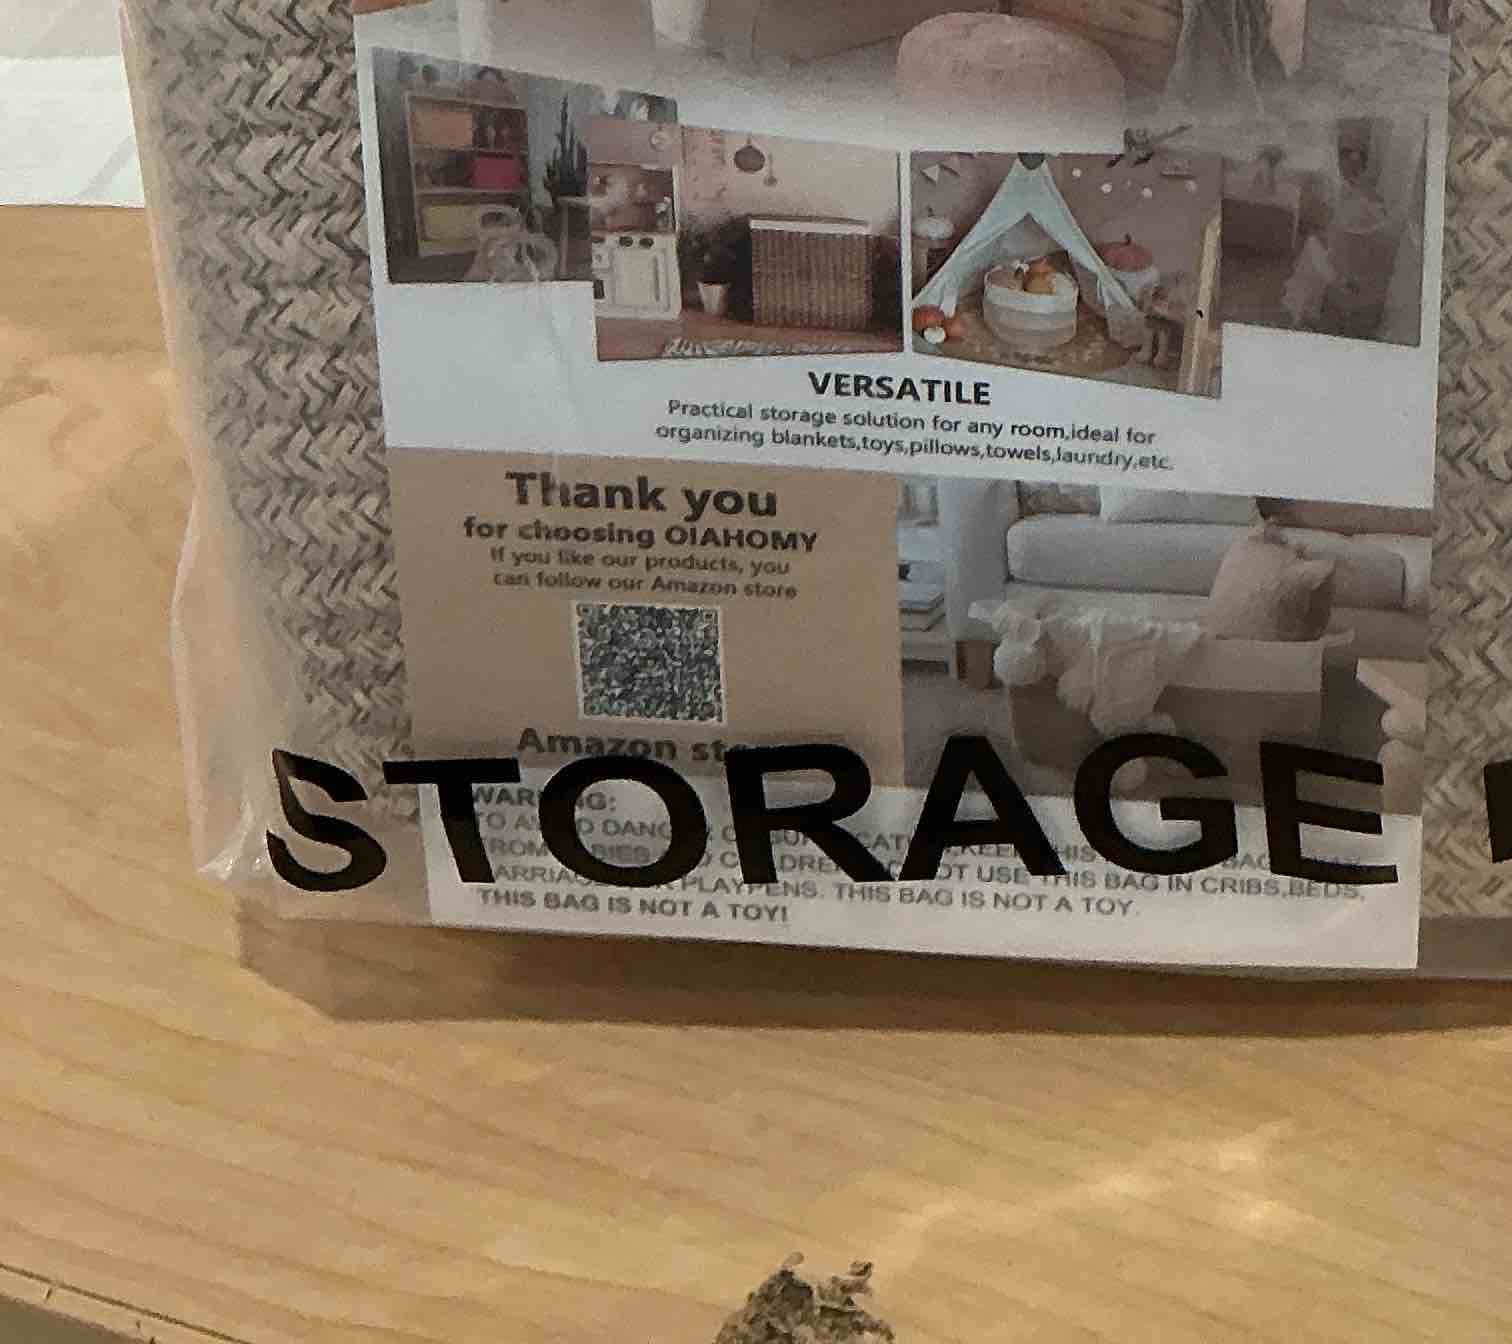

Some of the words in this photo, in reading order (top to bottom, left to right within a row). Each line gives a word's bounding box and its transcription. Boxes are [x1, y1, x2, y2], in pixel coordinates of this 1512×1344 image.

[808, 371, 991, 405] VERSATILE
[656, 424, 764, 449] organizing
[667, 399, 753, 420] Practical
[760, 405, 836, 428] storage
[843, 410, 925, 431] solution
[932, 415, 960, 432] for
[967, 420, 1003, 439] any
[1126, 427, 1156, 445] for
[505, 471, 667, 512] Thank
[681, 487, 778, 522] you
[463, 516, 508, 540] for
[518, 519, 655, 550] choosing
[665, 524, 818, 553] OIAHOMY
[490, 547, 505, 563] If
[511, 550, 551, 568] you
[558, 548, 594, 567] like
[602, 554, 637, 569] our
[645, 555, 744, 577] products,
[750, 560, 790, 578] you
[493, 570, 529, 587] can
[536, 569, 602, 590] follow
[608, 576, 645, 592] our
[651, 575, 738, 596] Amazon
[743, 578, 798, 599] store
[518, 727, 678, 761] Amazon
[267, 732, 1398, 891] STORAGE
[977, 865, 1029, 884] USE
[1168, 876, 1192, 892] IN
[481, 888, 537, 908] THIS
[543, 892, 600, 912] BAG
[608, 895, 632, 914] IS
[640, 897, 692, 918] NOT
[701, 900, 721, 919] A
[833, 882, 891, 903] THIS
[899, 886, 953, 907] BAG
[962, 891, 985, 908] IS
[993, 892, 1049, 912] NOT
[1054, 895, 1074, 913] A
